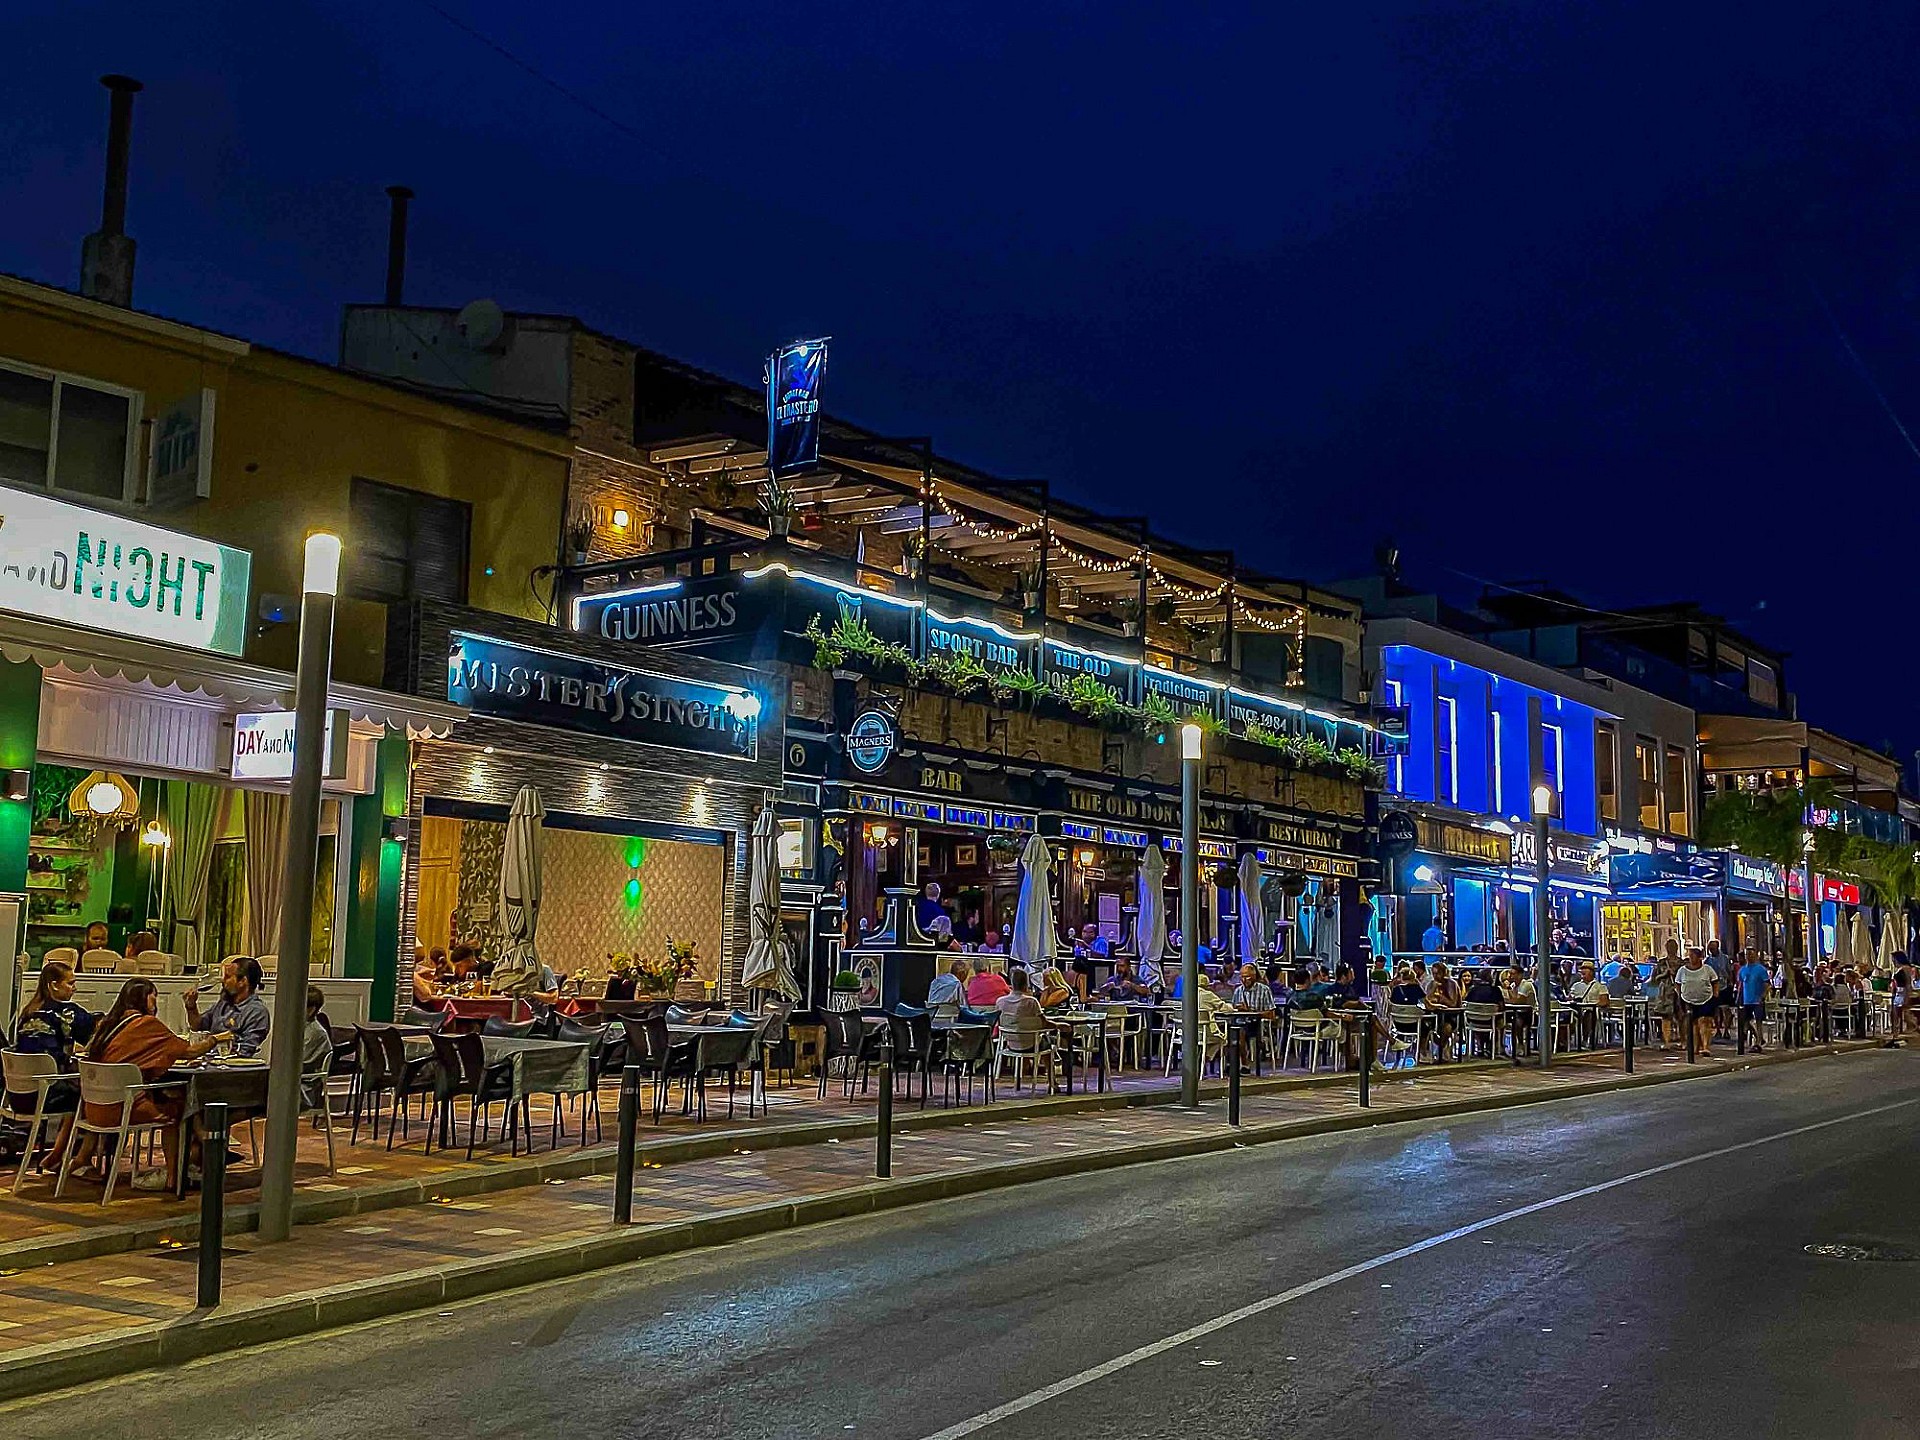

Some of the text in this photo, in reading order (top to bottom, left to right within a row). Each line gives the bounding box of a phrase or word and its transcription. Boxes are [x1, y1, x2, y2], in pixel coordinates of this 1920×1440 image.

[600, 590, 738, 641] GUINNESS
[930, 628, 1018, 667] SPORT BAR
[1054, 650, 1111, 677] THE OLD
[236, 729, 265, 756] DAY
[850, 735, 891, 748] MAGNERS
[920, 767, 962, 792] BAR
[1068, 790, 1102, 812] THE
[1105, 795, 1137, 818] OLD
[1141, 801, 1174, 824] DON
